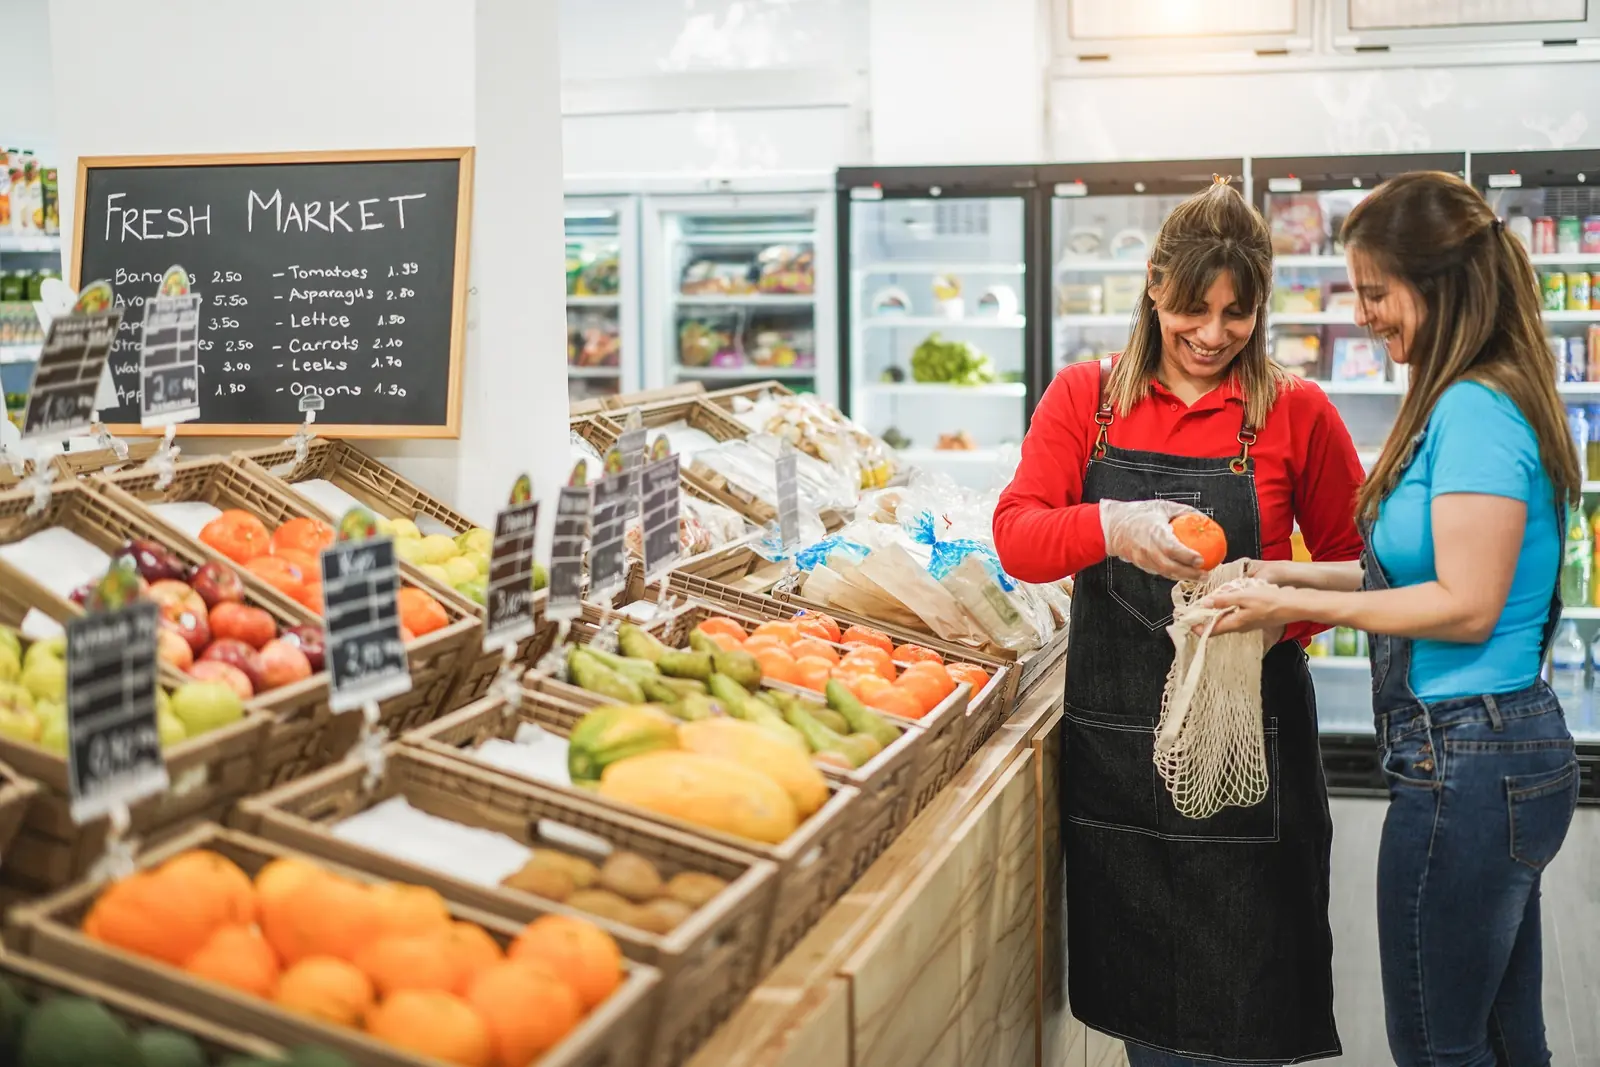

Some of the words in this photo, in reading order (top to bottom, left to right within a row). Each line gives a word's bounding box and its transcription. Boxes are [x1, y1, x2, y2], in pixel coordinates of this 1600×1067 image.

[105, 192, 210, 243] FRESH
[247, 188, 427, 234] MARKET
[115, 267, 196, 286] Banas
[211, 270, 243, 284] 2.50
[288, 264, 369, 280] Tomatoes
[387, 261, 419, 278] 1.99
[212, 294, 249, 307] 5.50
[288, 287, 374, 306] Asparagus
[386, 287, 416, 301] 2.80
[207, 316, 240, 331] 3.50
[290, 311, 351, 328] Lettce
[377, 314, 406, 327] 1.50
[225, 339, 254, 352] 2.50
[288, 335, 359, 353] Carrots
[372, 337, 404, 350] 2.10
[222, 360, 252, 373] 3.00
[291, 357, 348, 372] Leeks
[370, 355, 403, 369] 1.70
[214, 382, 247, 397] 1.80
[289, 381, 362, 397] Onions
[373, 382, 407, 398] 1.30
